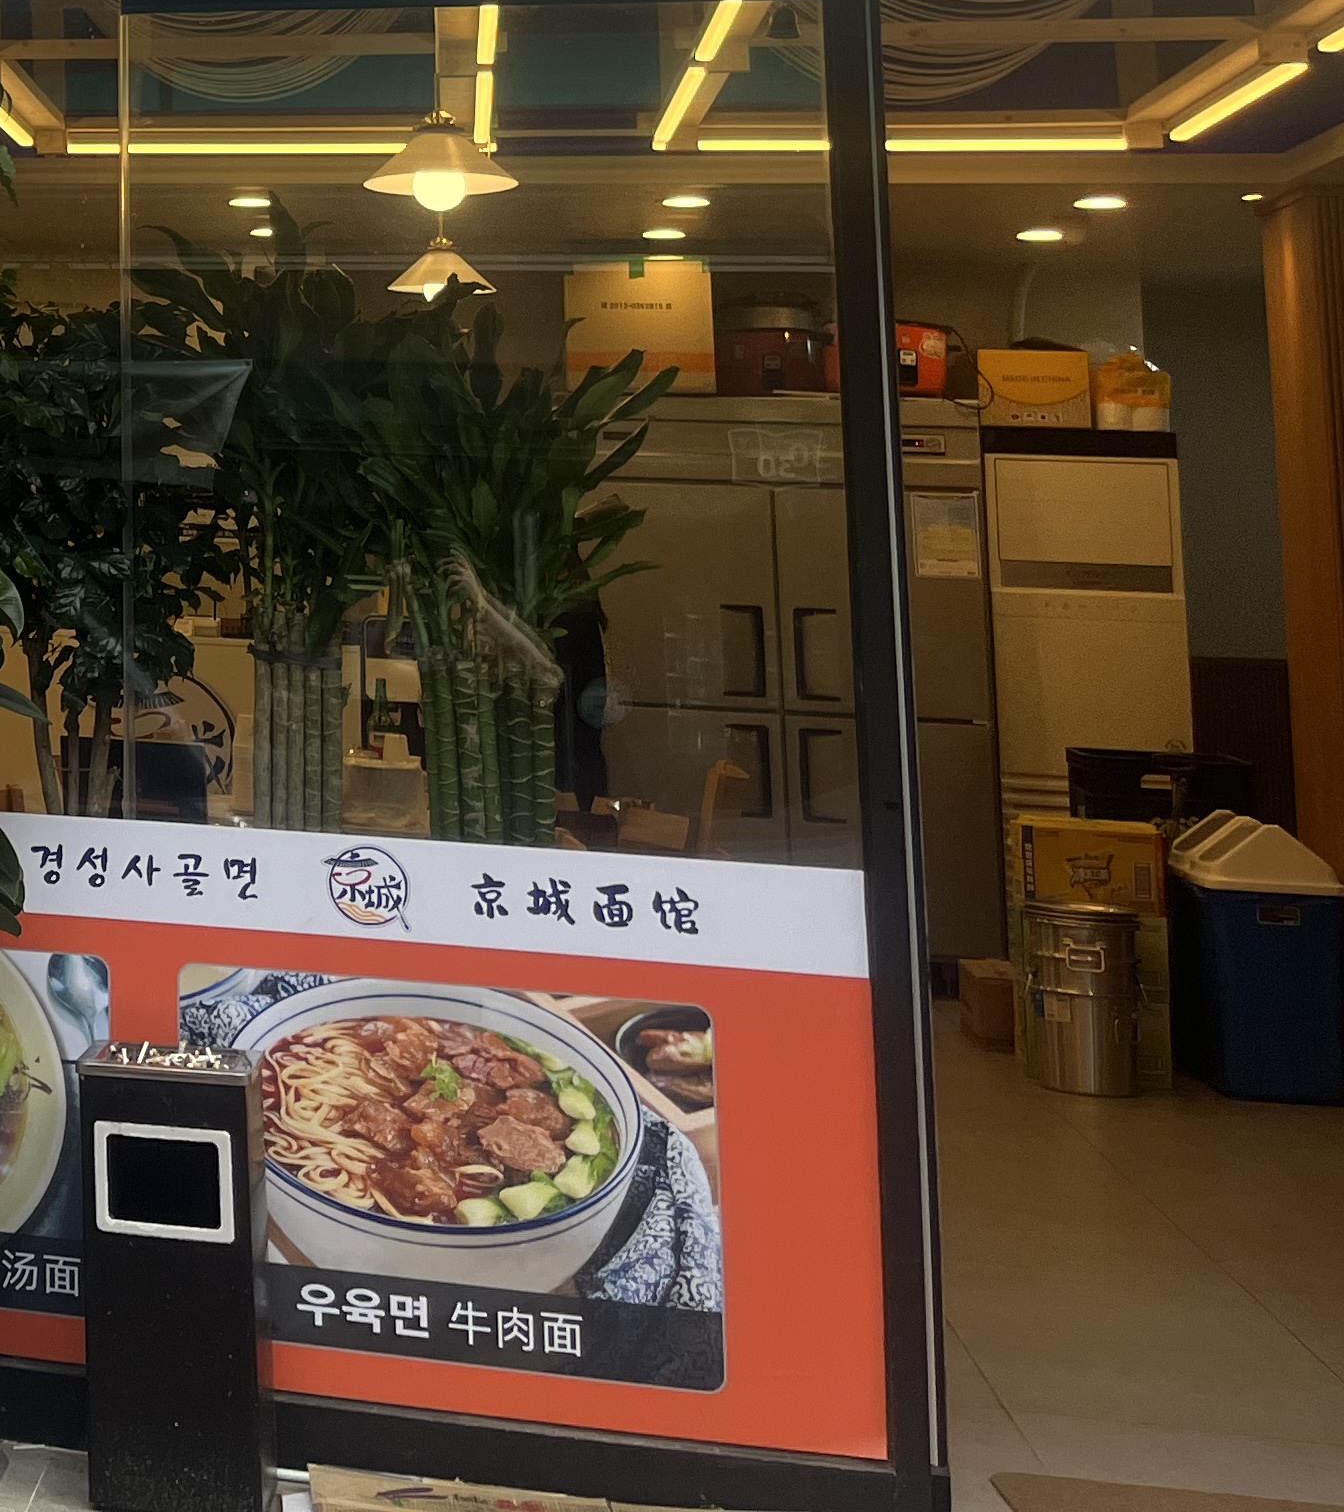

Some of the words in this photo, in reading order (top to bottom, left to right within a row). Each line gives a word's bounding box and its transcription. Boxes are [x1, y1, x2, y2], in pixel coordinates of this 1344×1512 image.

[30, 845, 260, 900] 경성사골면
[471, 872, 699, 935] 京城面馆
[296, 1282, 430, 1340] 우육면
[448, 1299, 584, 1357] 牛肉面
